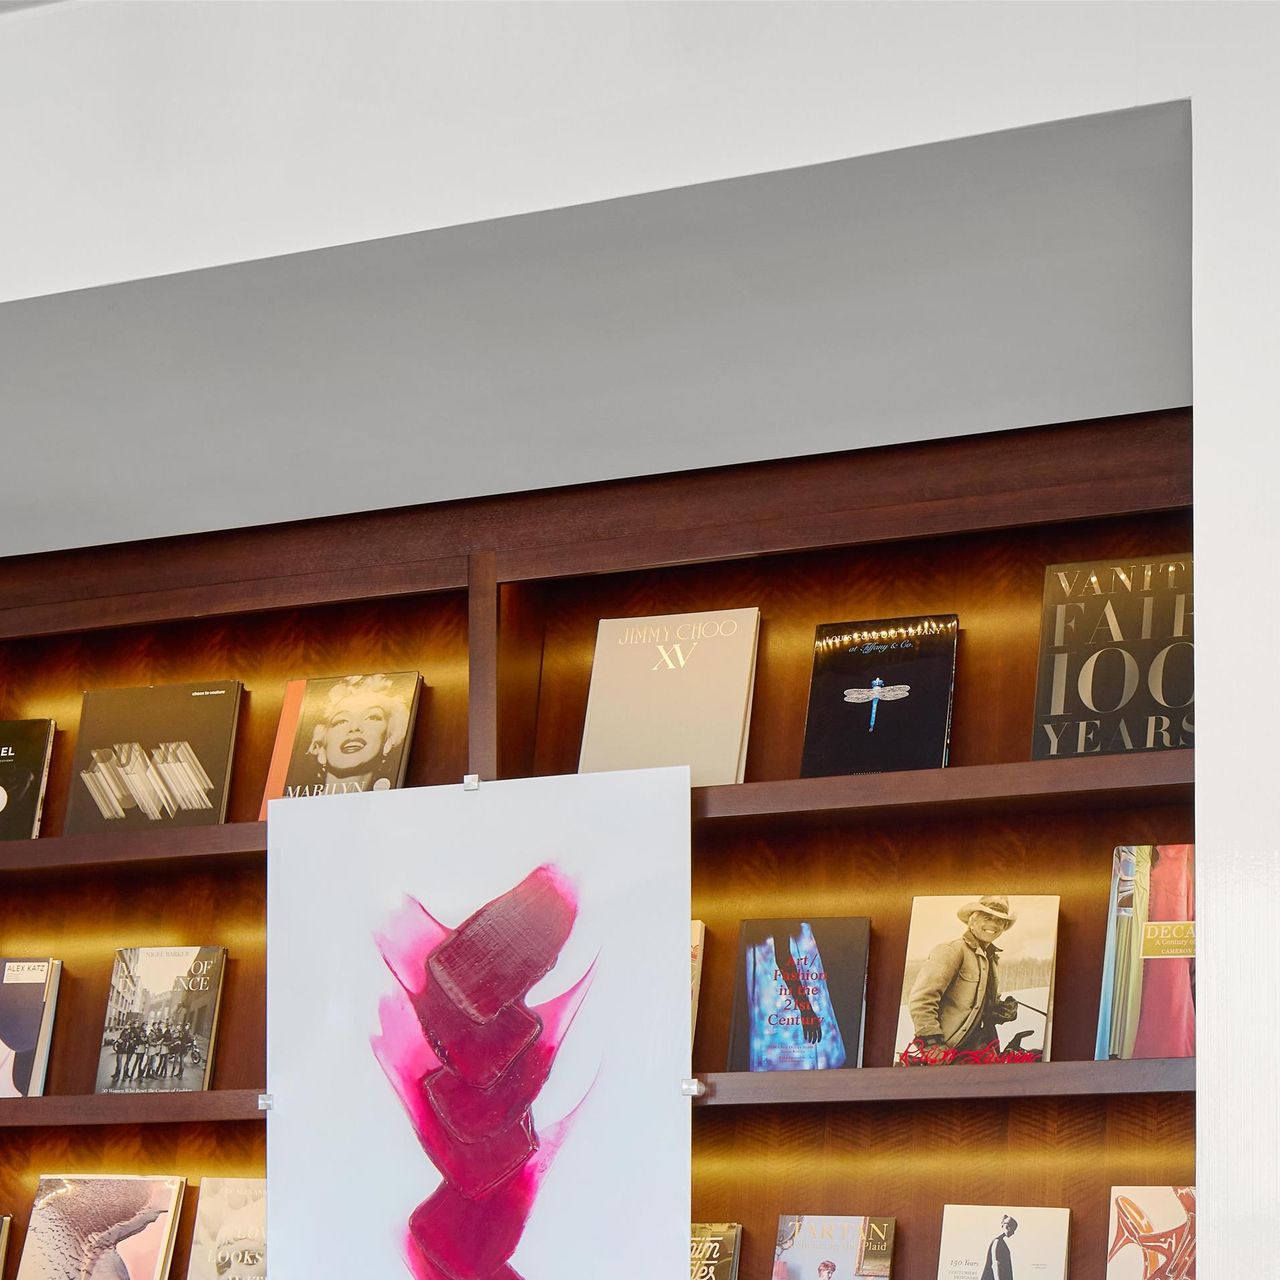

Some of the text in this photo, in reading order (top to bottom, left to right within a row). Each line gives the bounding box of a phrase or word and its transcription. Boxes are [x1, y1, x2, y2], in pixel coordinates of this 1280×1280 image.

[1054, 561, 1187, 598] VANIT
[619, 619, 738, 645] JIMMY CHOO
[824, 627, 942, 644] LOUIS COMFORT TIFFANY
[860, 642, 889, 654] Tiffany
[900, 640, 914, 649] Co.
[651, 641, 699, 671] XV
[1040, 714, 1195, 755] YEARS
[7, 964, 46, 972] ALEX KATZ
[190, 960, 214, 975] OF
[773, 969, 828, 981] Fashion
[779, 984, 819, 996] in the
[783, 999, 811, 1011] 21st
[767, 1014, 825, 1026] Century
[863, 1241, 887, 1251] Plaid
[207, 1250, 264, 1265] LOOKS
